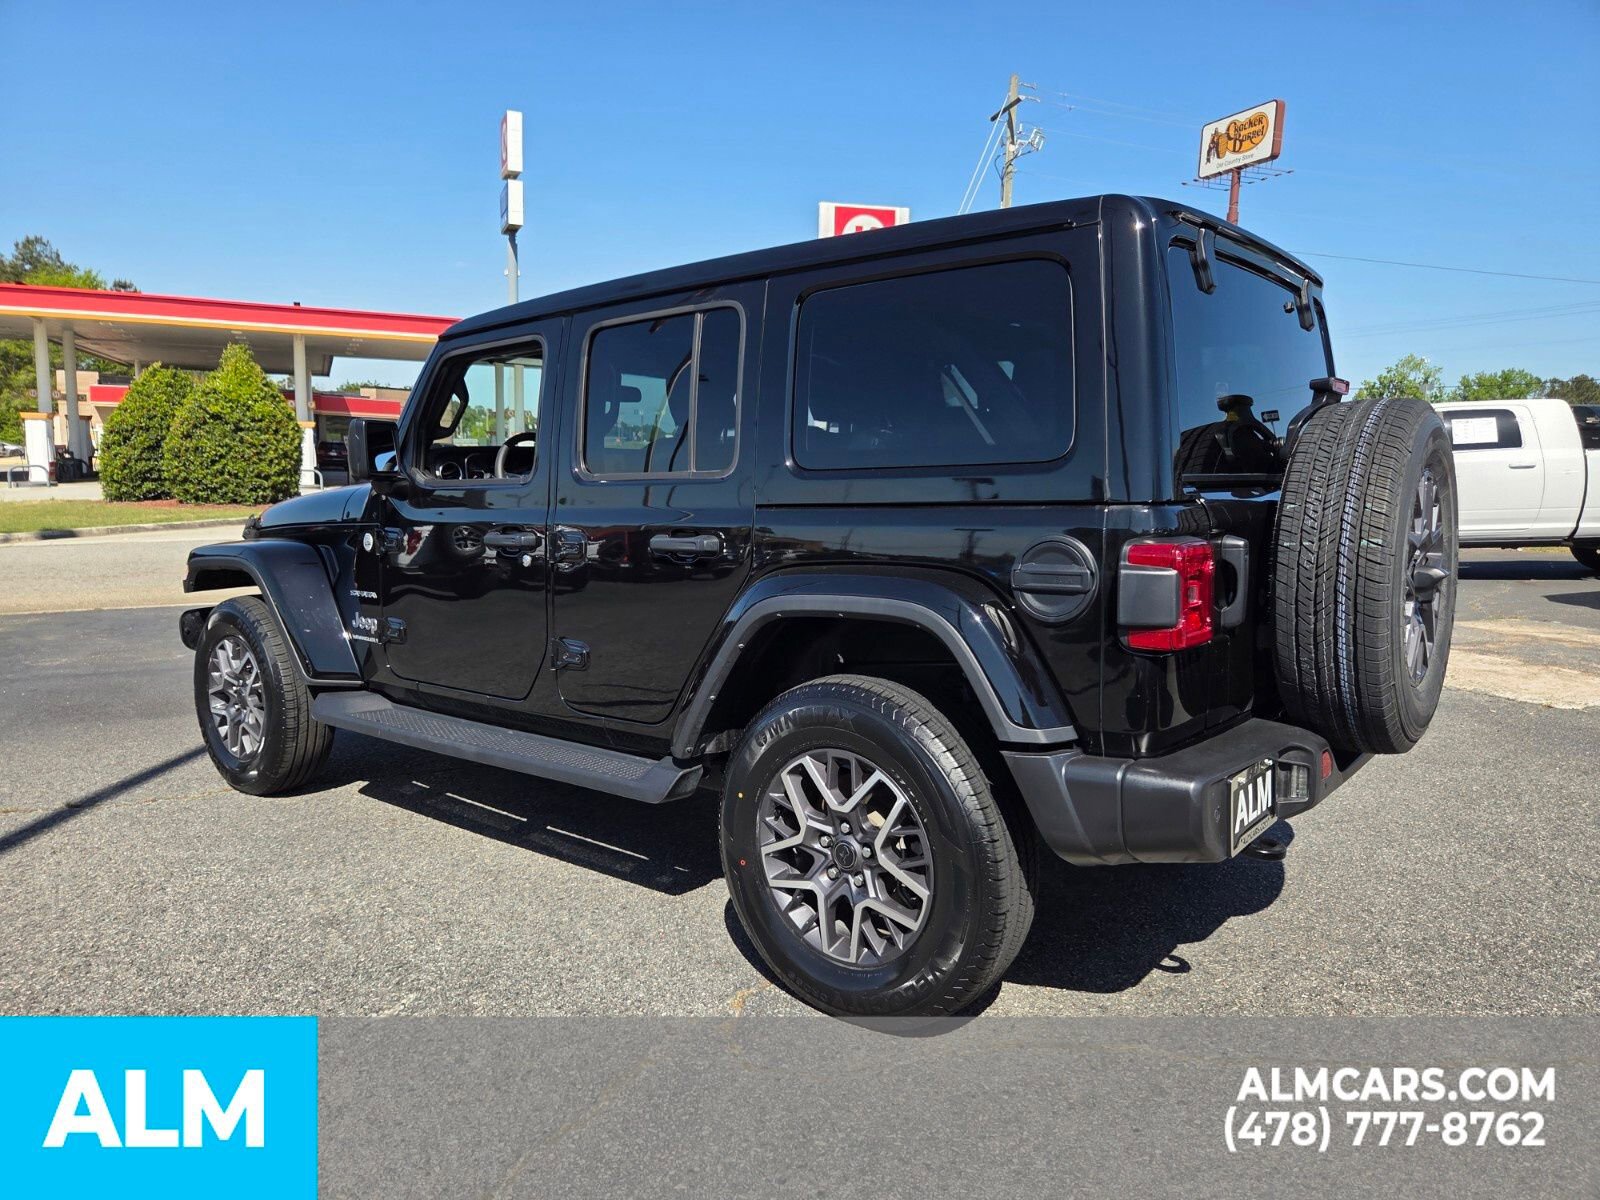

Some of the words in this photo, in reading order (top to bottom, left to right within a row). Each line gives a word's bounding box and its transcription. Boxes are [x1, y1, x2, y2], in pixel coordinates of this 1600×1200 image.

[1227, 116, 1264, 140] Cracker
[1233, 126, 1264, 152] Barrel
[352, 612, 377, 634] Jeep
[1234, 769, 1272, 834] ALM
